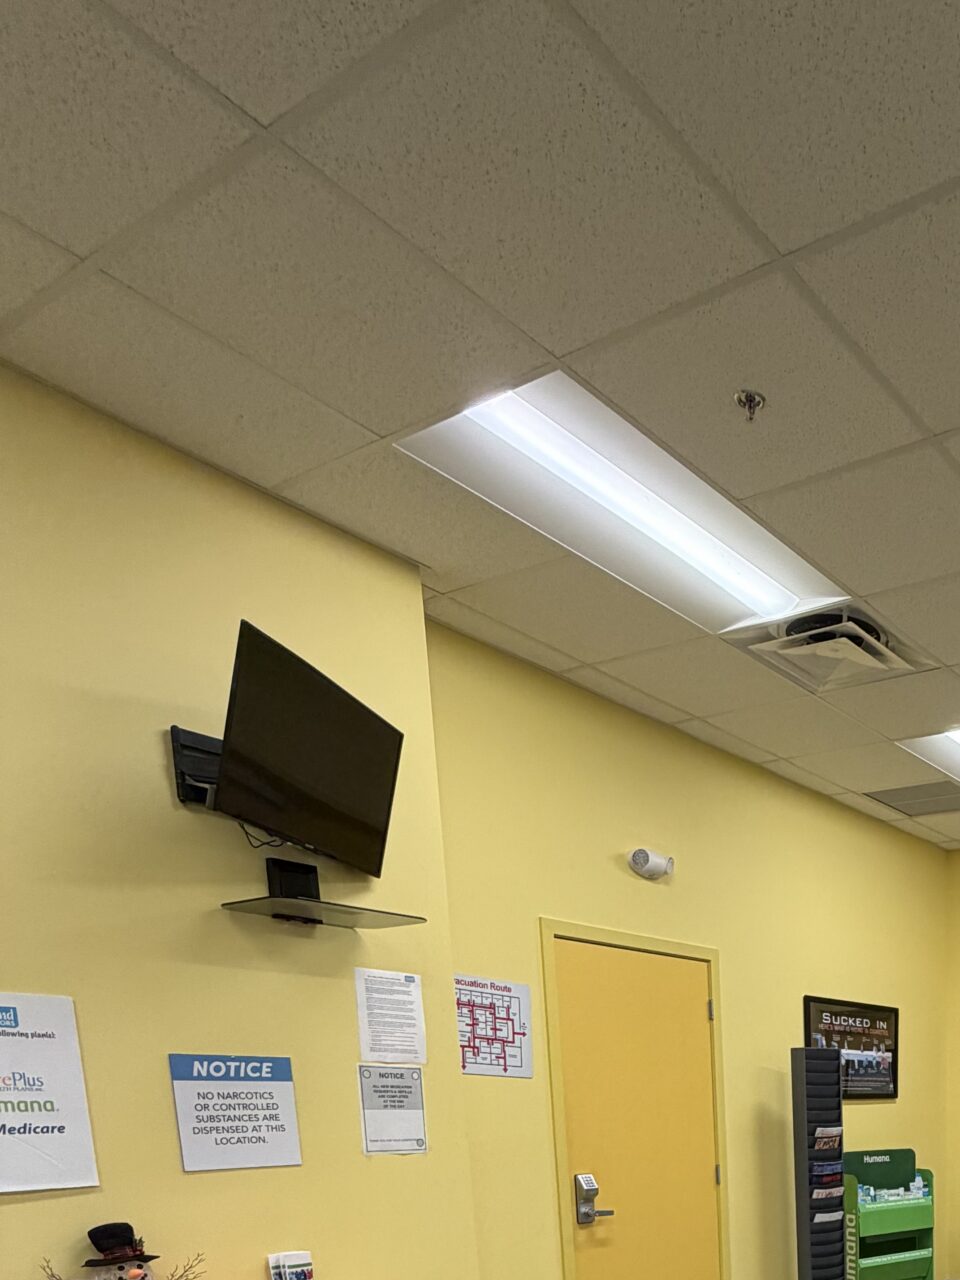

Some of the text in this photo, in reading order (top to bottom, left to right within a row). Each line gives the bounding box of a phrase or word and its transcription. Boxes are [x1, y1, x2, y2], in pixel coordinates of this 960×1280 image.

[454, 978, 512, 992] acuation Route
[192, 1060, 272, 1077] NOTICE
[197, 1092, 274, 1100] NO NARCOTICS
[194, 1103, 279, 1111] OR CONTROLLED
[195, 1114, 259, 1123] SUBSTANCES
[0, 1123, 66, 1135] Medicare
[192, 1126, 248, 1134] DISPENSED
[264, 1124, 286, 1132] THIS
[215, 1136, 268, 1145] LOCATION.
